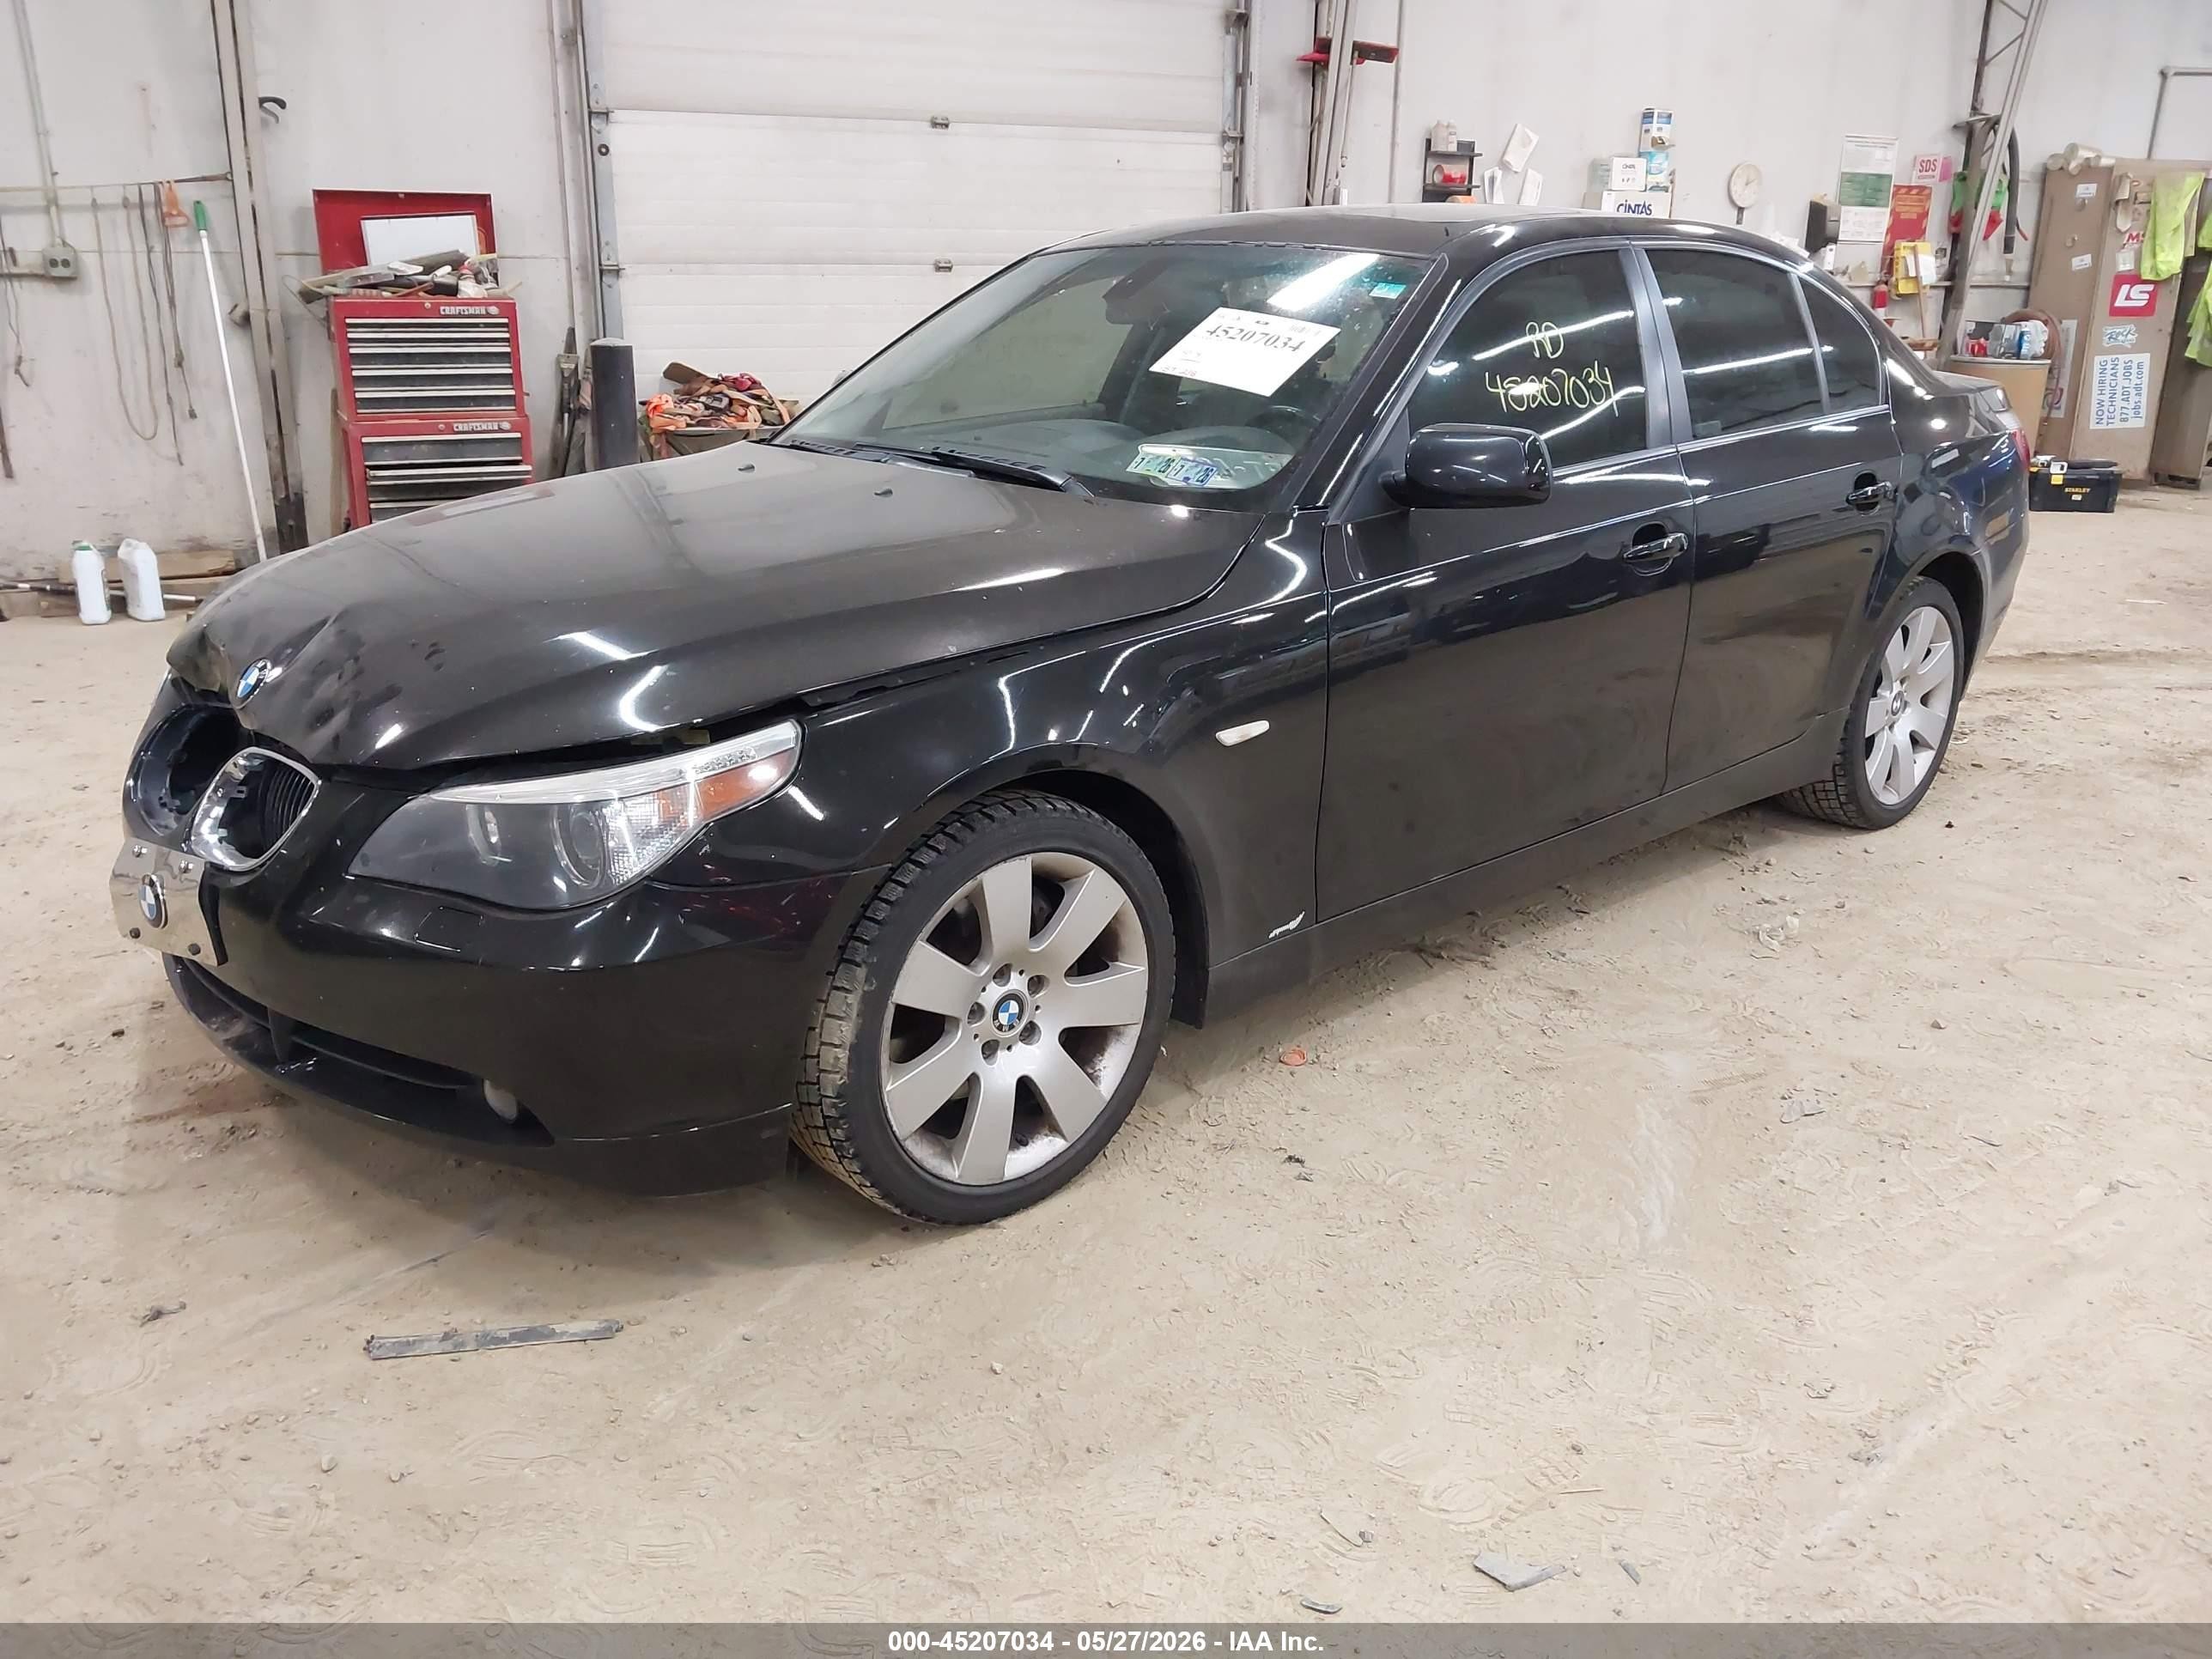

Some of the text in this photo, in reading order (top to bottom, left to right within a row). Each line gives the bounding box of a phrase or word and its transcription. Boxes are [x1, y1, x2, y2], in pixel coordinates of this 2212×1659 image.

[1918, 158, 1938, 173] SDS
[1616, 199, 1652, 216] CINTAS
[2113, 283, 2155, 307] LS
[440, 306, 487, 315] CRAFTSMAN
[1206, 324, 1306, 353] 45207034
[1485, 360, 1620, 418] 45207034
[2095, 359, 2108, 425] NOW HIRING
[2106, 356, 2119, 426] TECHNICIANS
[2131, 361, 2144, 419] jobs.adt.com
[453, 422, 499, 432] CRAFTSMAN
[1159, 457, 1176, 473] 26
[1195, 467, 1214, 483] 26
